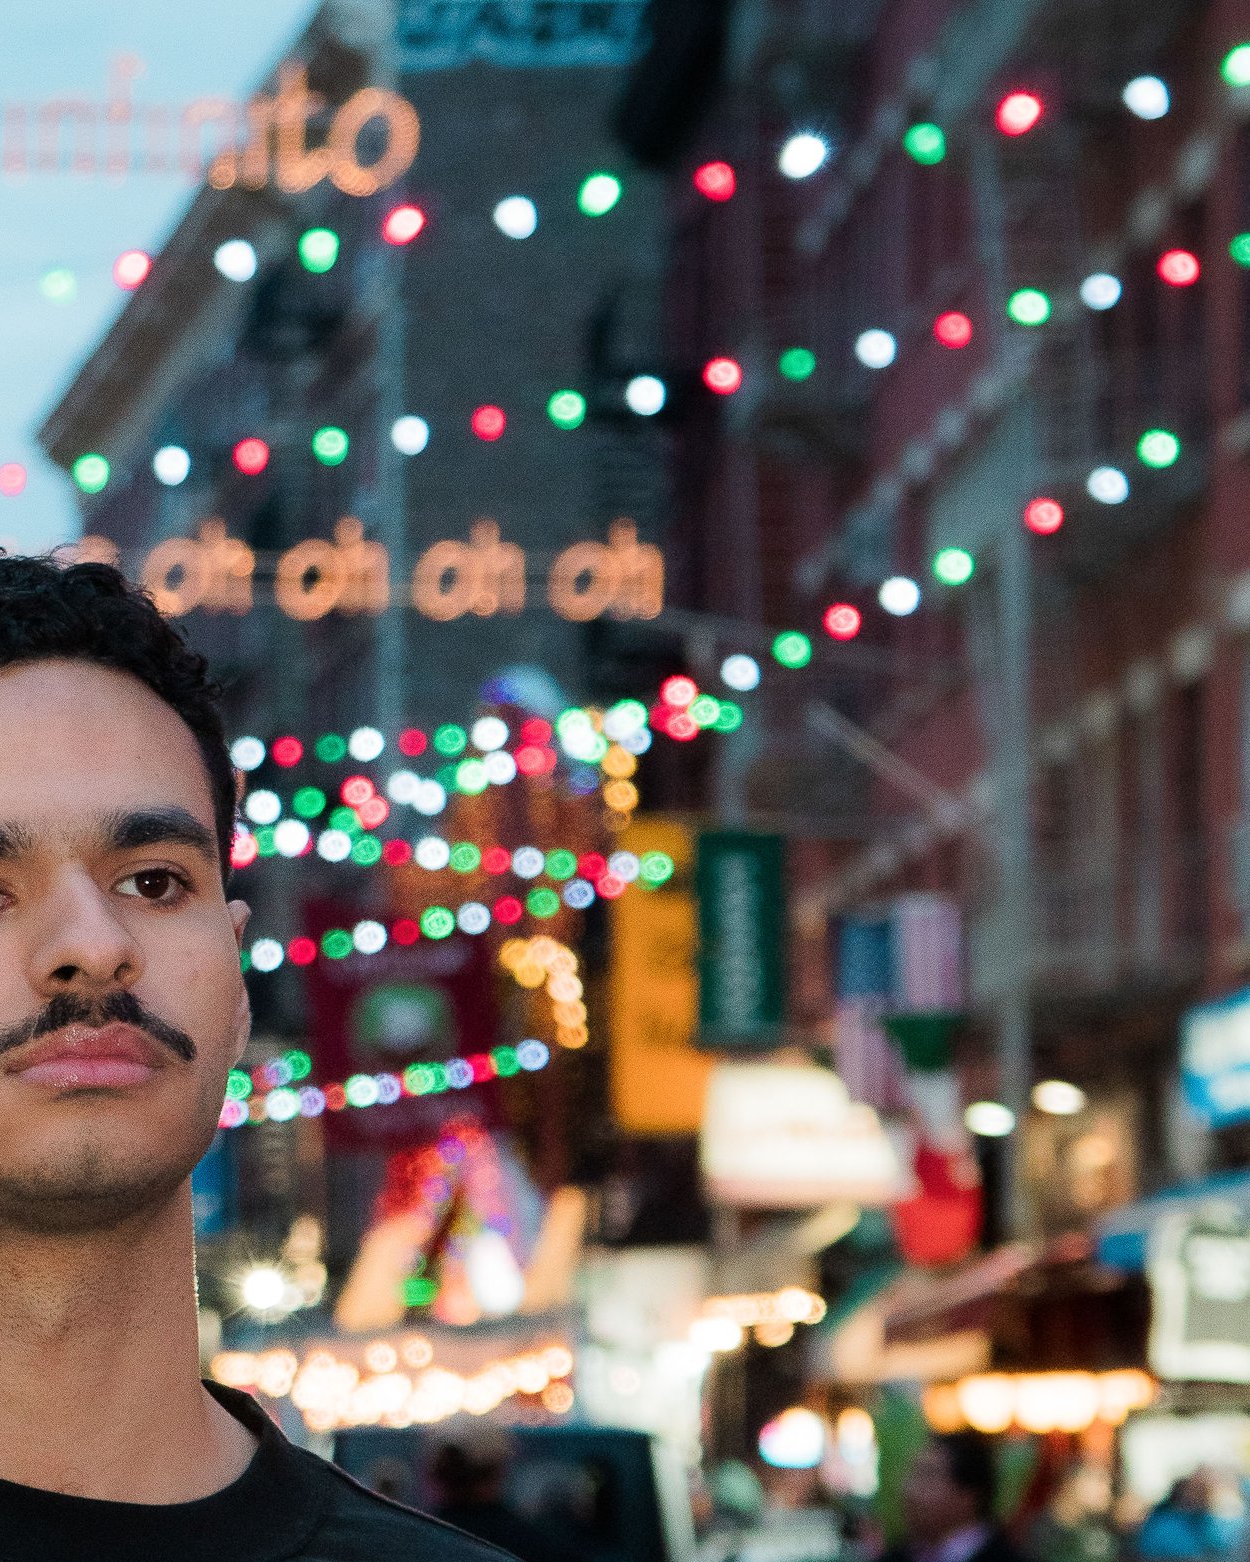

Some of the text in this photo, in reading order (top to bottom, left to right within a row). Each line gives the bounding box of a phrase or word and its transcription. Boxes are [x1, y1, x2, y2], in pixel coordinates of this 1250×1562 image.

[274, 515, 391, 621] oh
[411, 518, 526, 622] oh
[550, 517, 665, 622] oh
